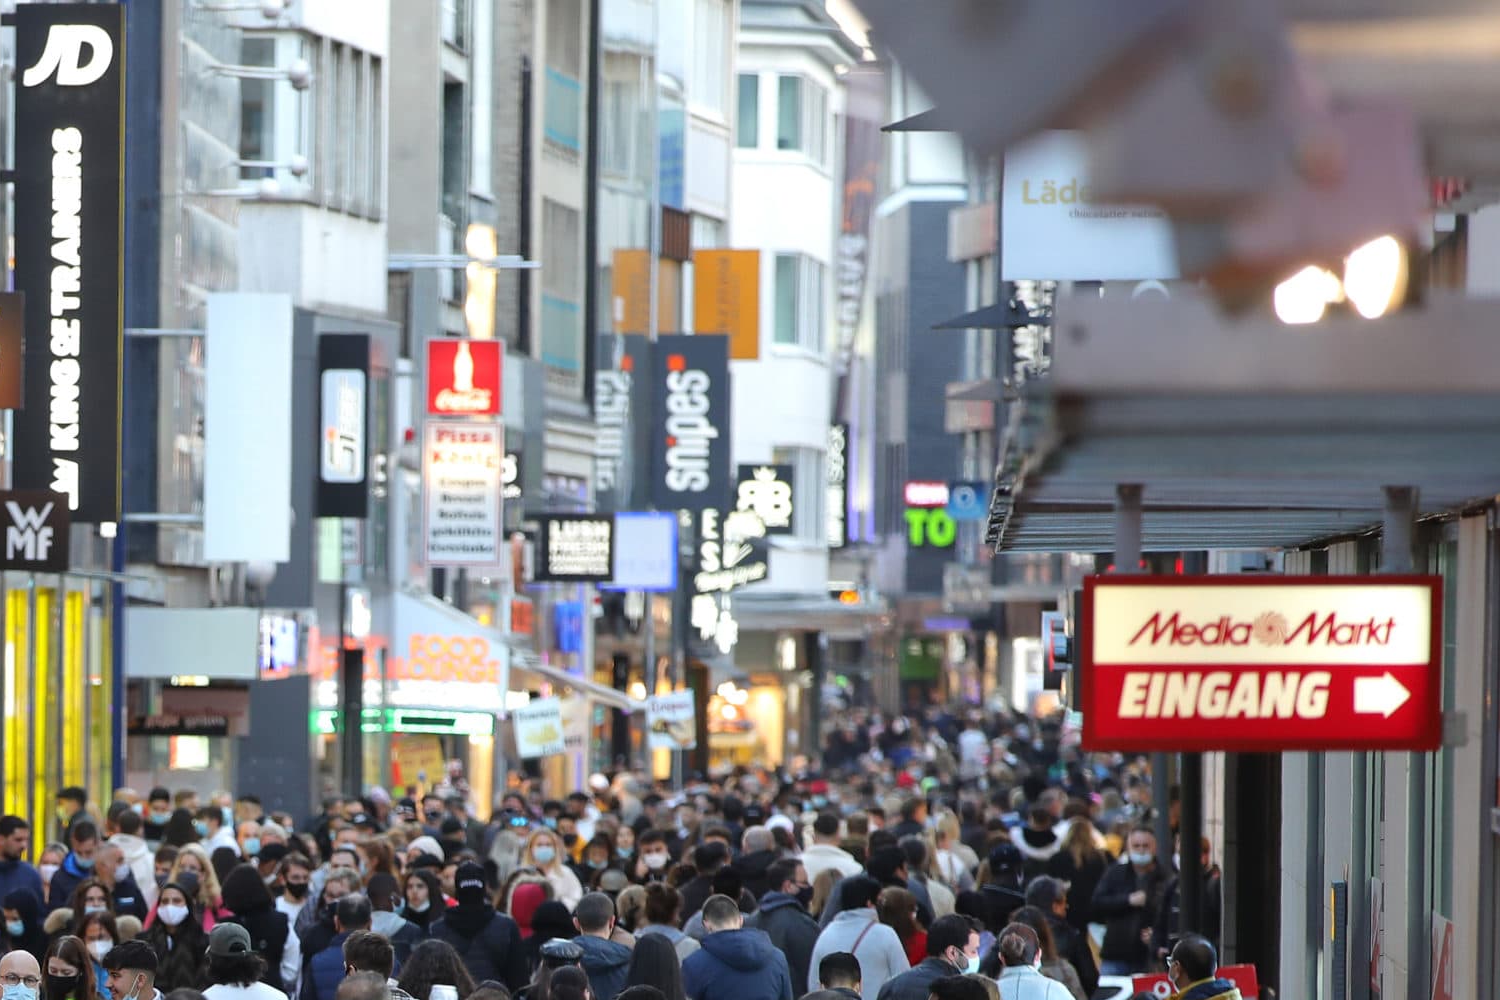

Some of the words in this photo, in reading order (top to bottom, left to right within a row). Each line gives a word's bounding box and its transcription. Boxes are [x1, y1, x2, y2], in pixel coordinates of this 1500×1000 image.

[23, 24, 114, 88] JD
[50, 126, 83, 317] TRAINERS
[409, 633, 490, 658] FOOD
[1129, 611, 1252, 646] Media
[1284, 611, 1397, 646] Markt
[1117, 671, 1332, 719] EINGANG
